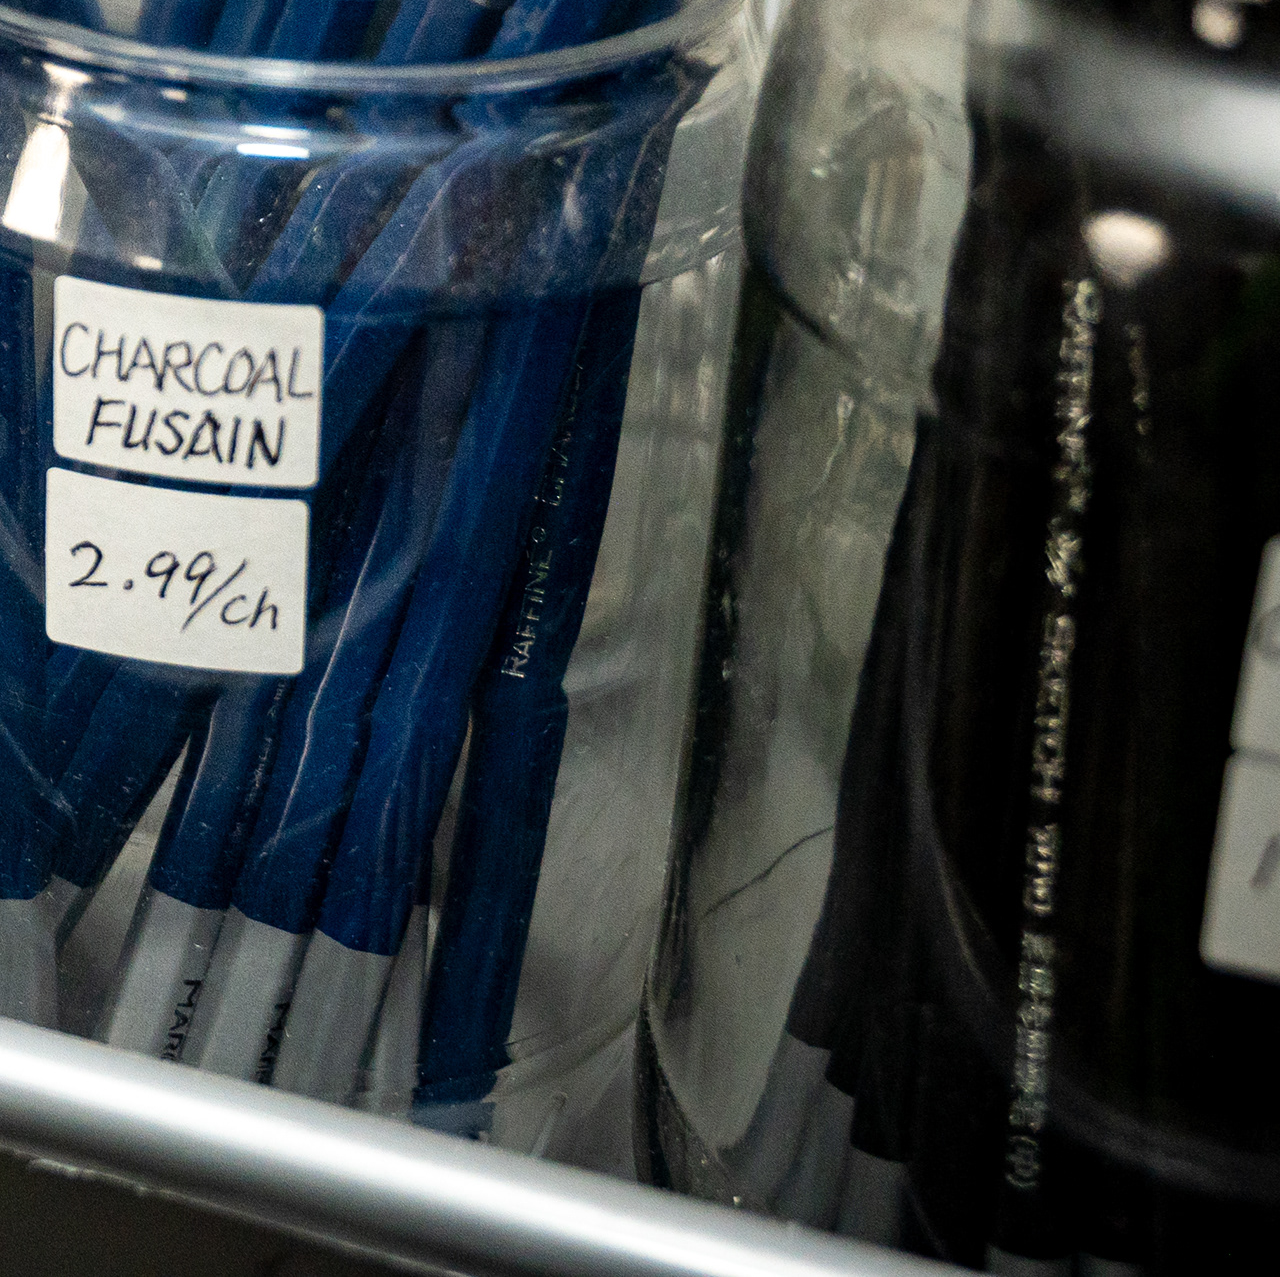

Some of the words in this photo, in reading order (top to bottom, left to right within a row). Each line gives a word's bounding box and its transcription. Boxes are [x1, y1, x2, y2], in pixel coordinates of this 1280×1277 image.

[59, 322, 314, 403] CHARCOAL
[85, 396, 286, 469] FUSAIN
[69, 539, 281, 634] 2.99/ch
